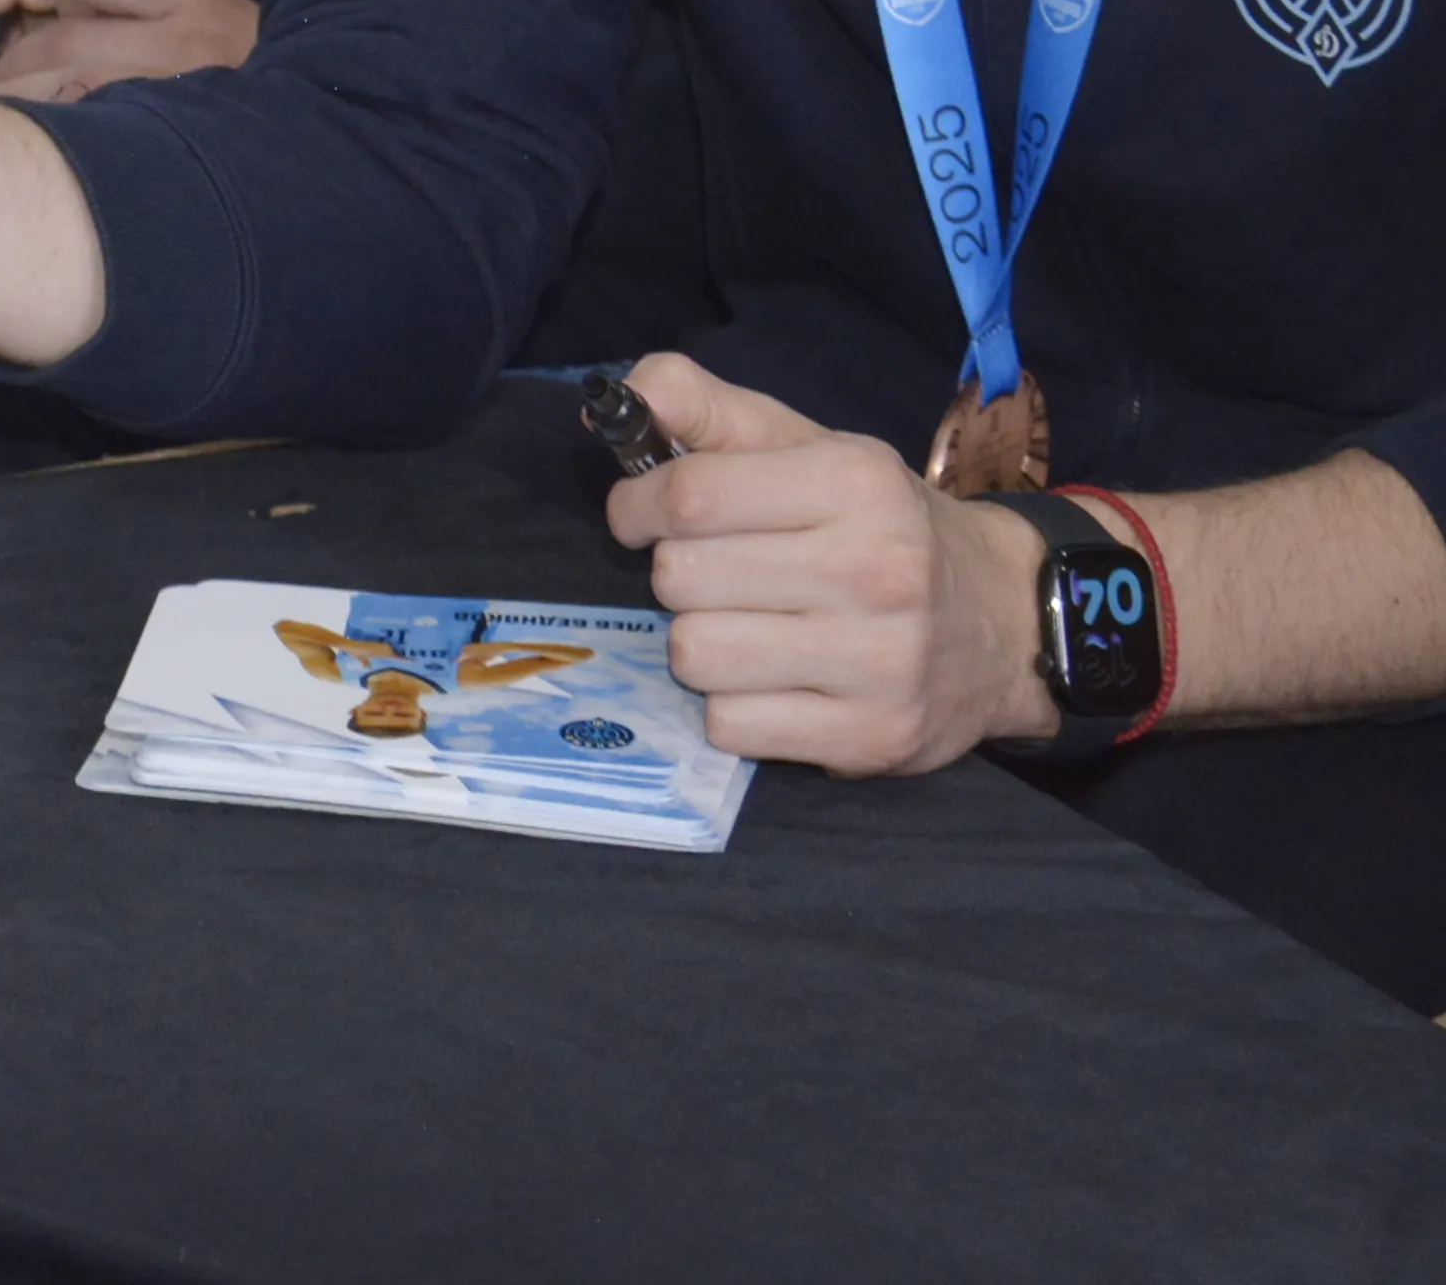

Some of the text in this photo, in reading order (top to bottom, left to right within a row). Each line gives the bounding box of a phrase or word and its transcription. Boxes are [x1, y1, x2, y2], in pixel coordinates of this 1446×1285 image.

[918, 104, 988, 264] 2025
[1011, 106, 1049, 224] 025
[594, 619, 656, 634] ГЛЕБ
